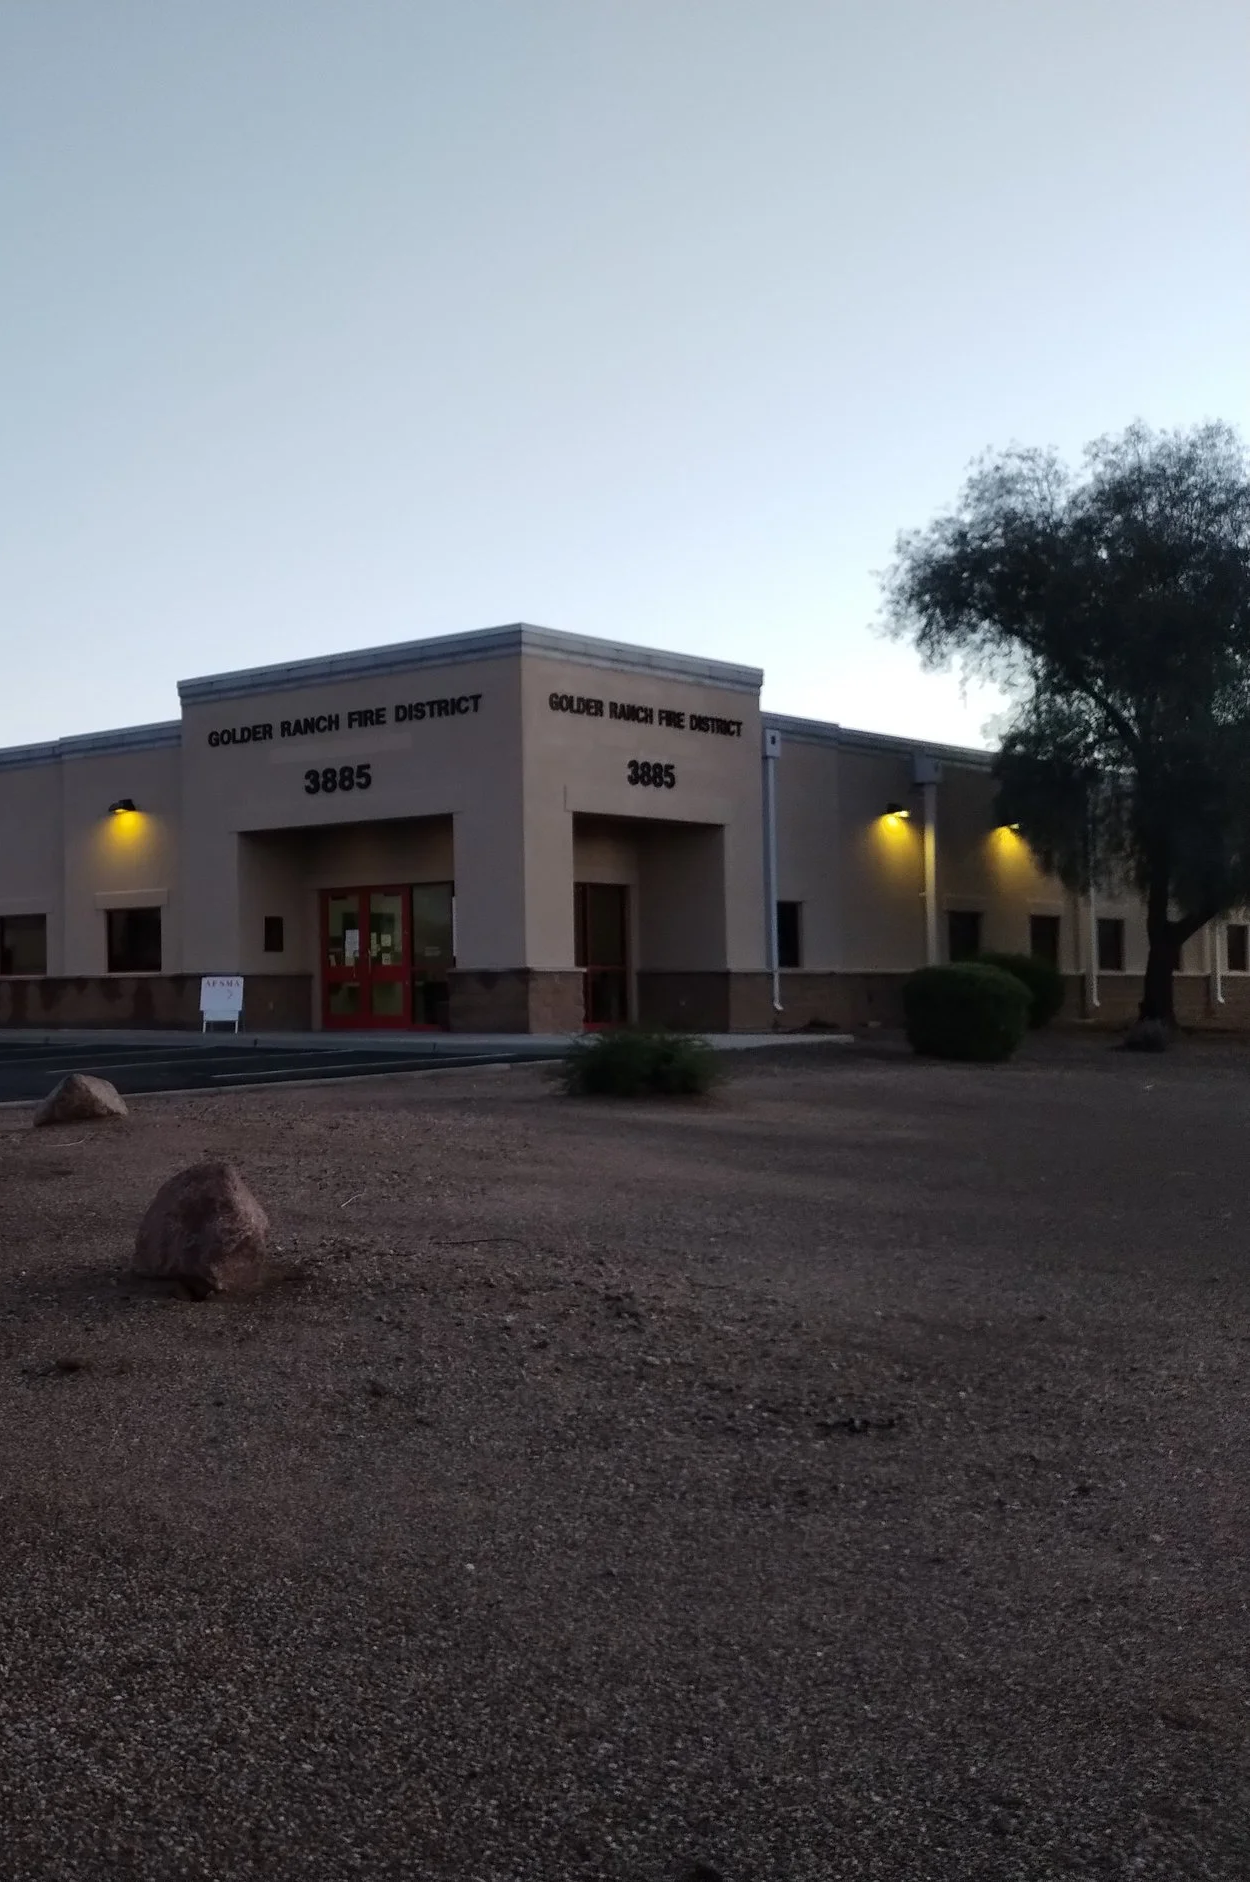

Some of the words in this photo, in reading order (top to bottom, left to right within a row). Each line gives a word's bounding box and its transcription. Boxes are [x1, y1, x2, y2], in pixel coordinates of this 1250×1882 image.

[208, 723, 273, 747] GOLDER
[280, 714, 340, 737] RANCH
[347, 707, 386, 729] FIRE
[395, 694, 482, 723] DISTRICT
[549, 692, 603, 718] GOLDER
[609, 701, 653, 725] RANCH
[658, 709, 685, 729] FIRE
[690, 714, 743, 737] DISTRICT
[304, 763, 372, 795] 3885
[627, 759, 676, 789] 3885
